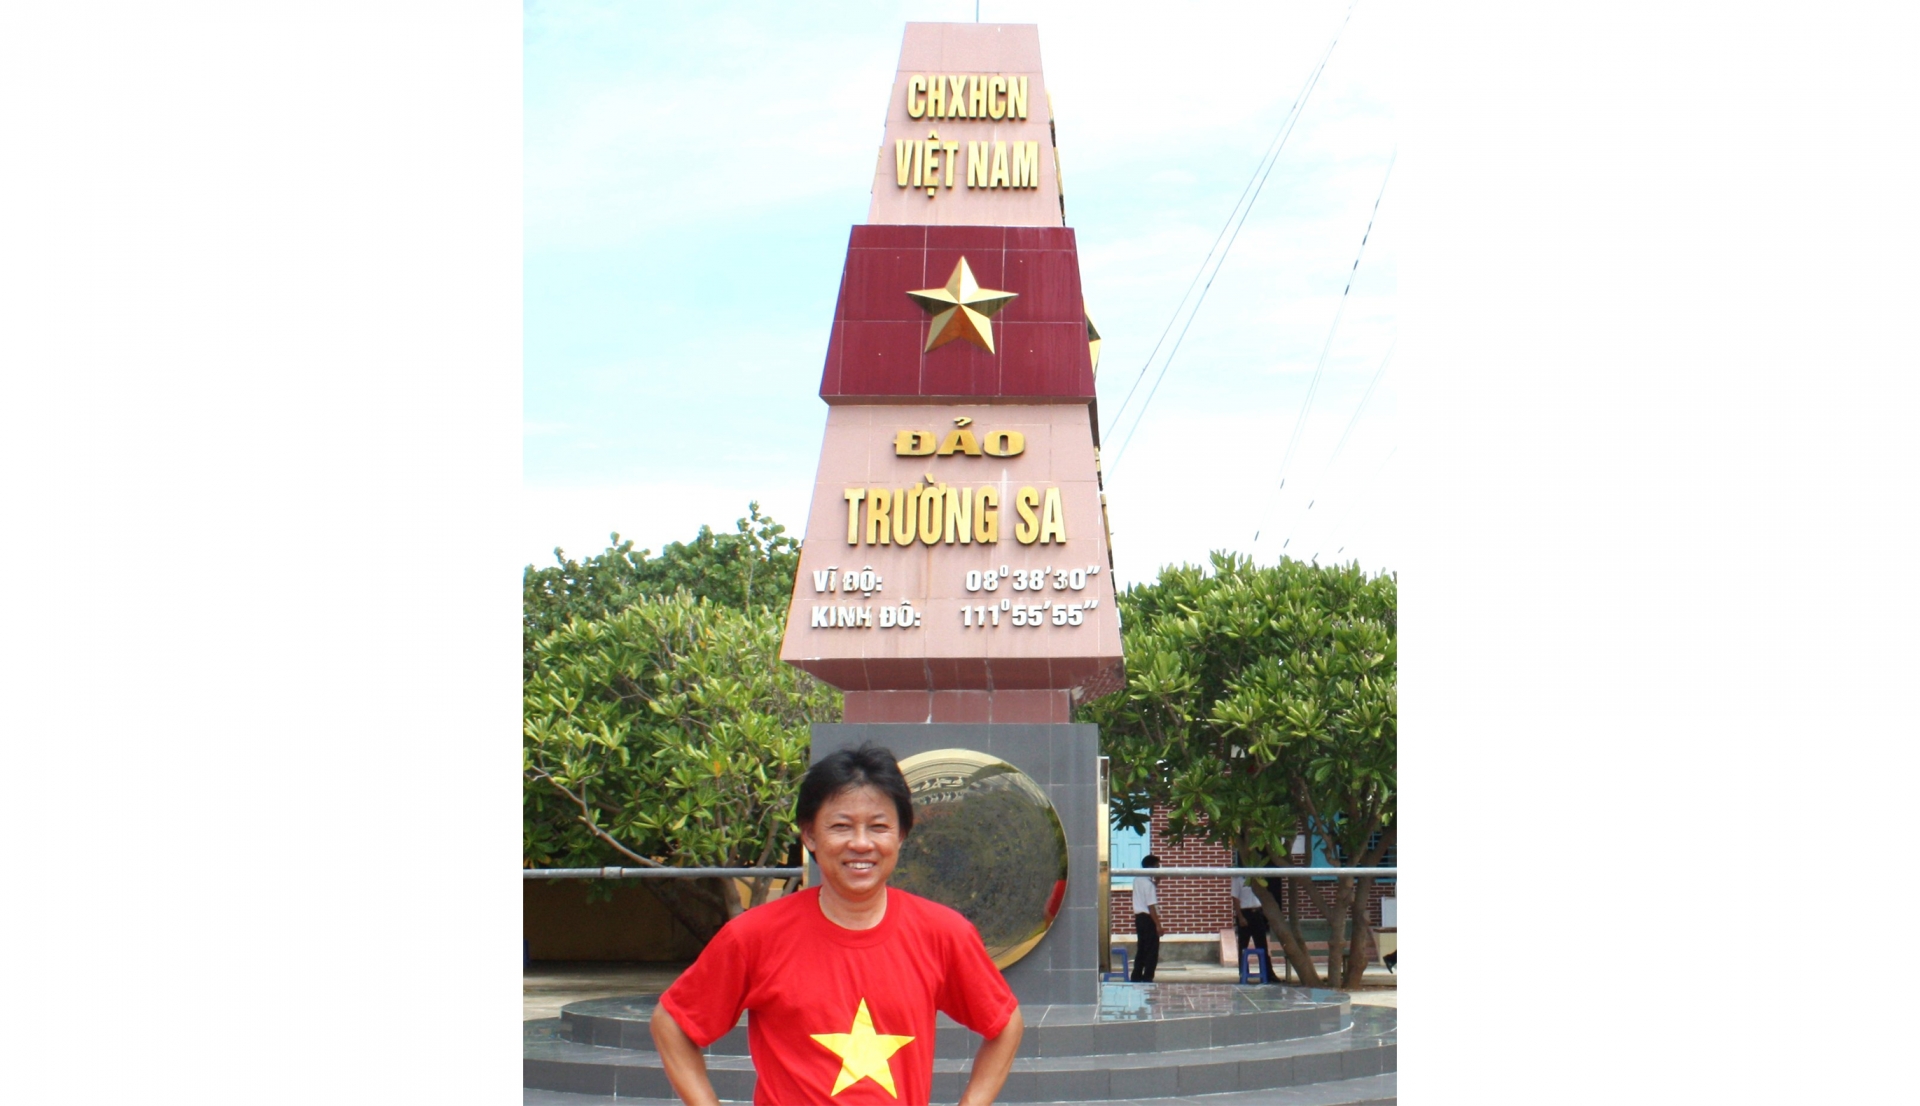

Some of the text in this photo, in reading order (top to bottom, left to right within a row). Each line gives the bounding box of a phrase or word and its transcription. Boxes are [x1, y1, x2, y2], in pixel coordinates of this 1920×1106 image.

[907, 74, 1028, 120] CHXHCN
[896, 129, 1039, 198] VIỆT NAM
[893, 416, 1026, 457] ĐẢO
[844, 473, 1067, 546] TRƯỜNG SA
[812, 566, 839, 593] VĨ
[842, 565, 883, 597] ĐỘ:
[811, 605, 873, 629] KINH
